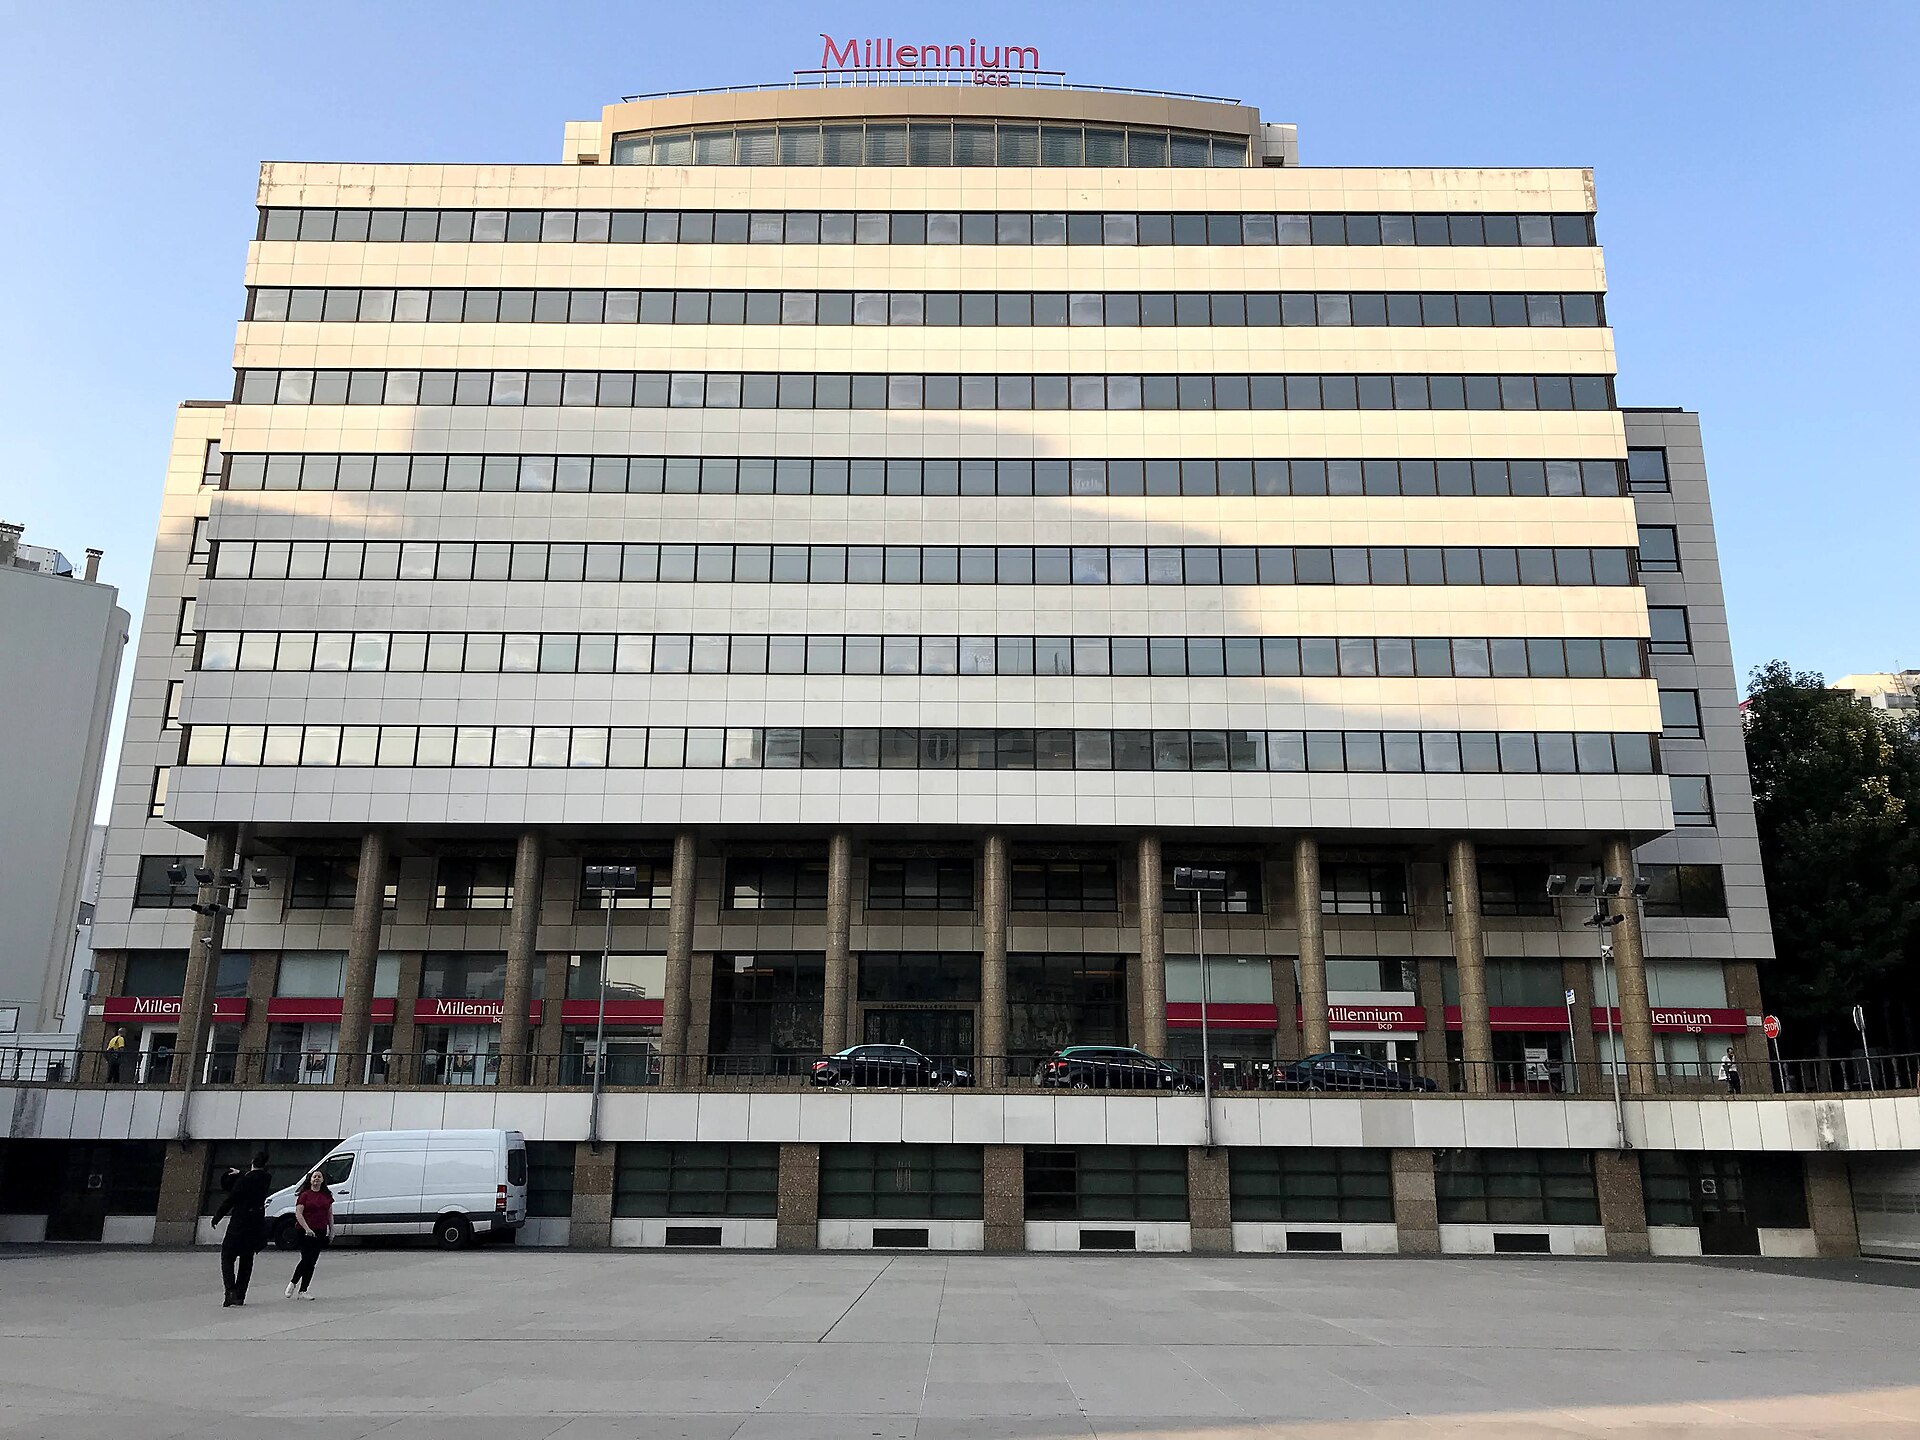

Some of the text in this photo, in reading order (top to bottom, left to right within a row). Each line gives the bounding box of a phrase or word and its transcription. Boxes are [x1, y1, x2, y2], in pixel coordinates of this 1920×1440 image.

[819, 33, 1040, 69] Millennium
[973, 69, 1010, 87] bcp
[133, 996, 219, 1013] Millen
[435, 998, 505, 1015] Millenniu
[492, 1015, 503, 1024] bc
[1651, 1010, 1712, 1024] lennium
[1377, 1022, 1393, 1031] bcp
[1686, 1025, 1702, 1033] bcp
[1763, 1022, 1778, 1032] STOP
